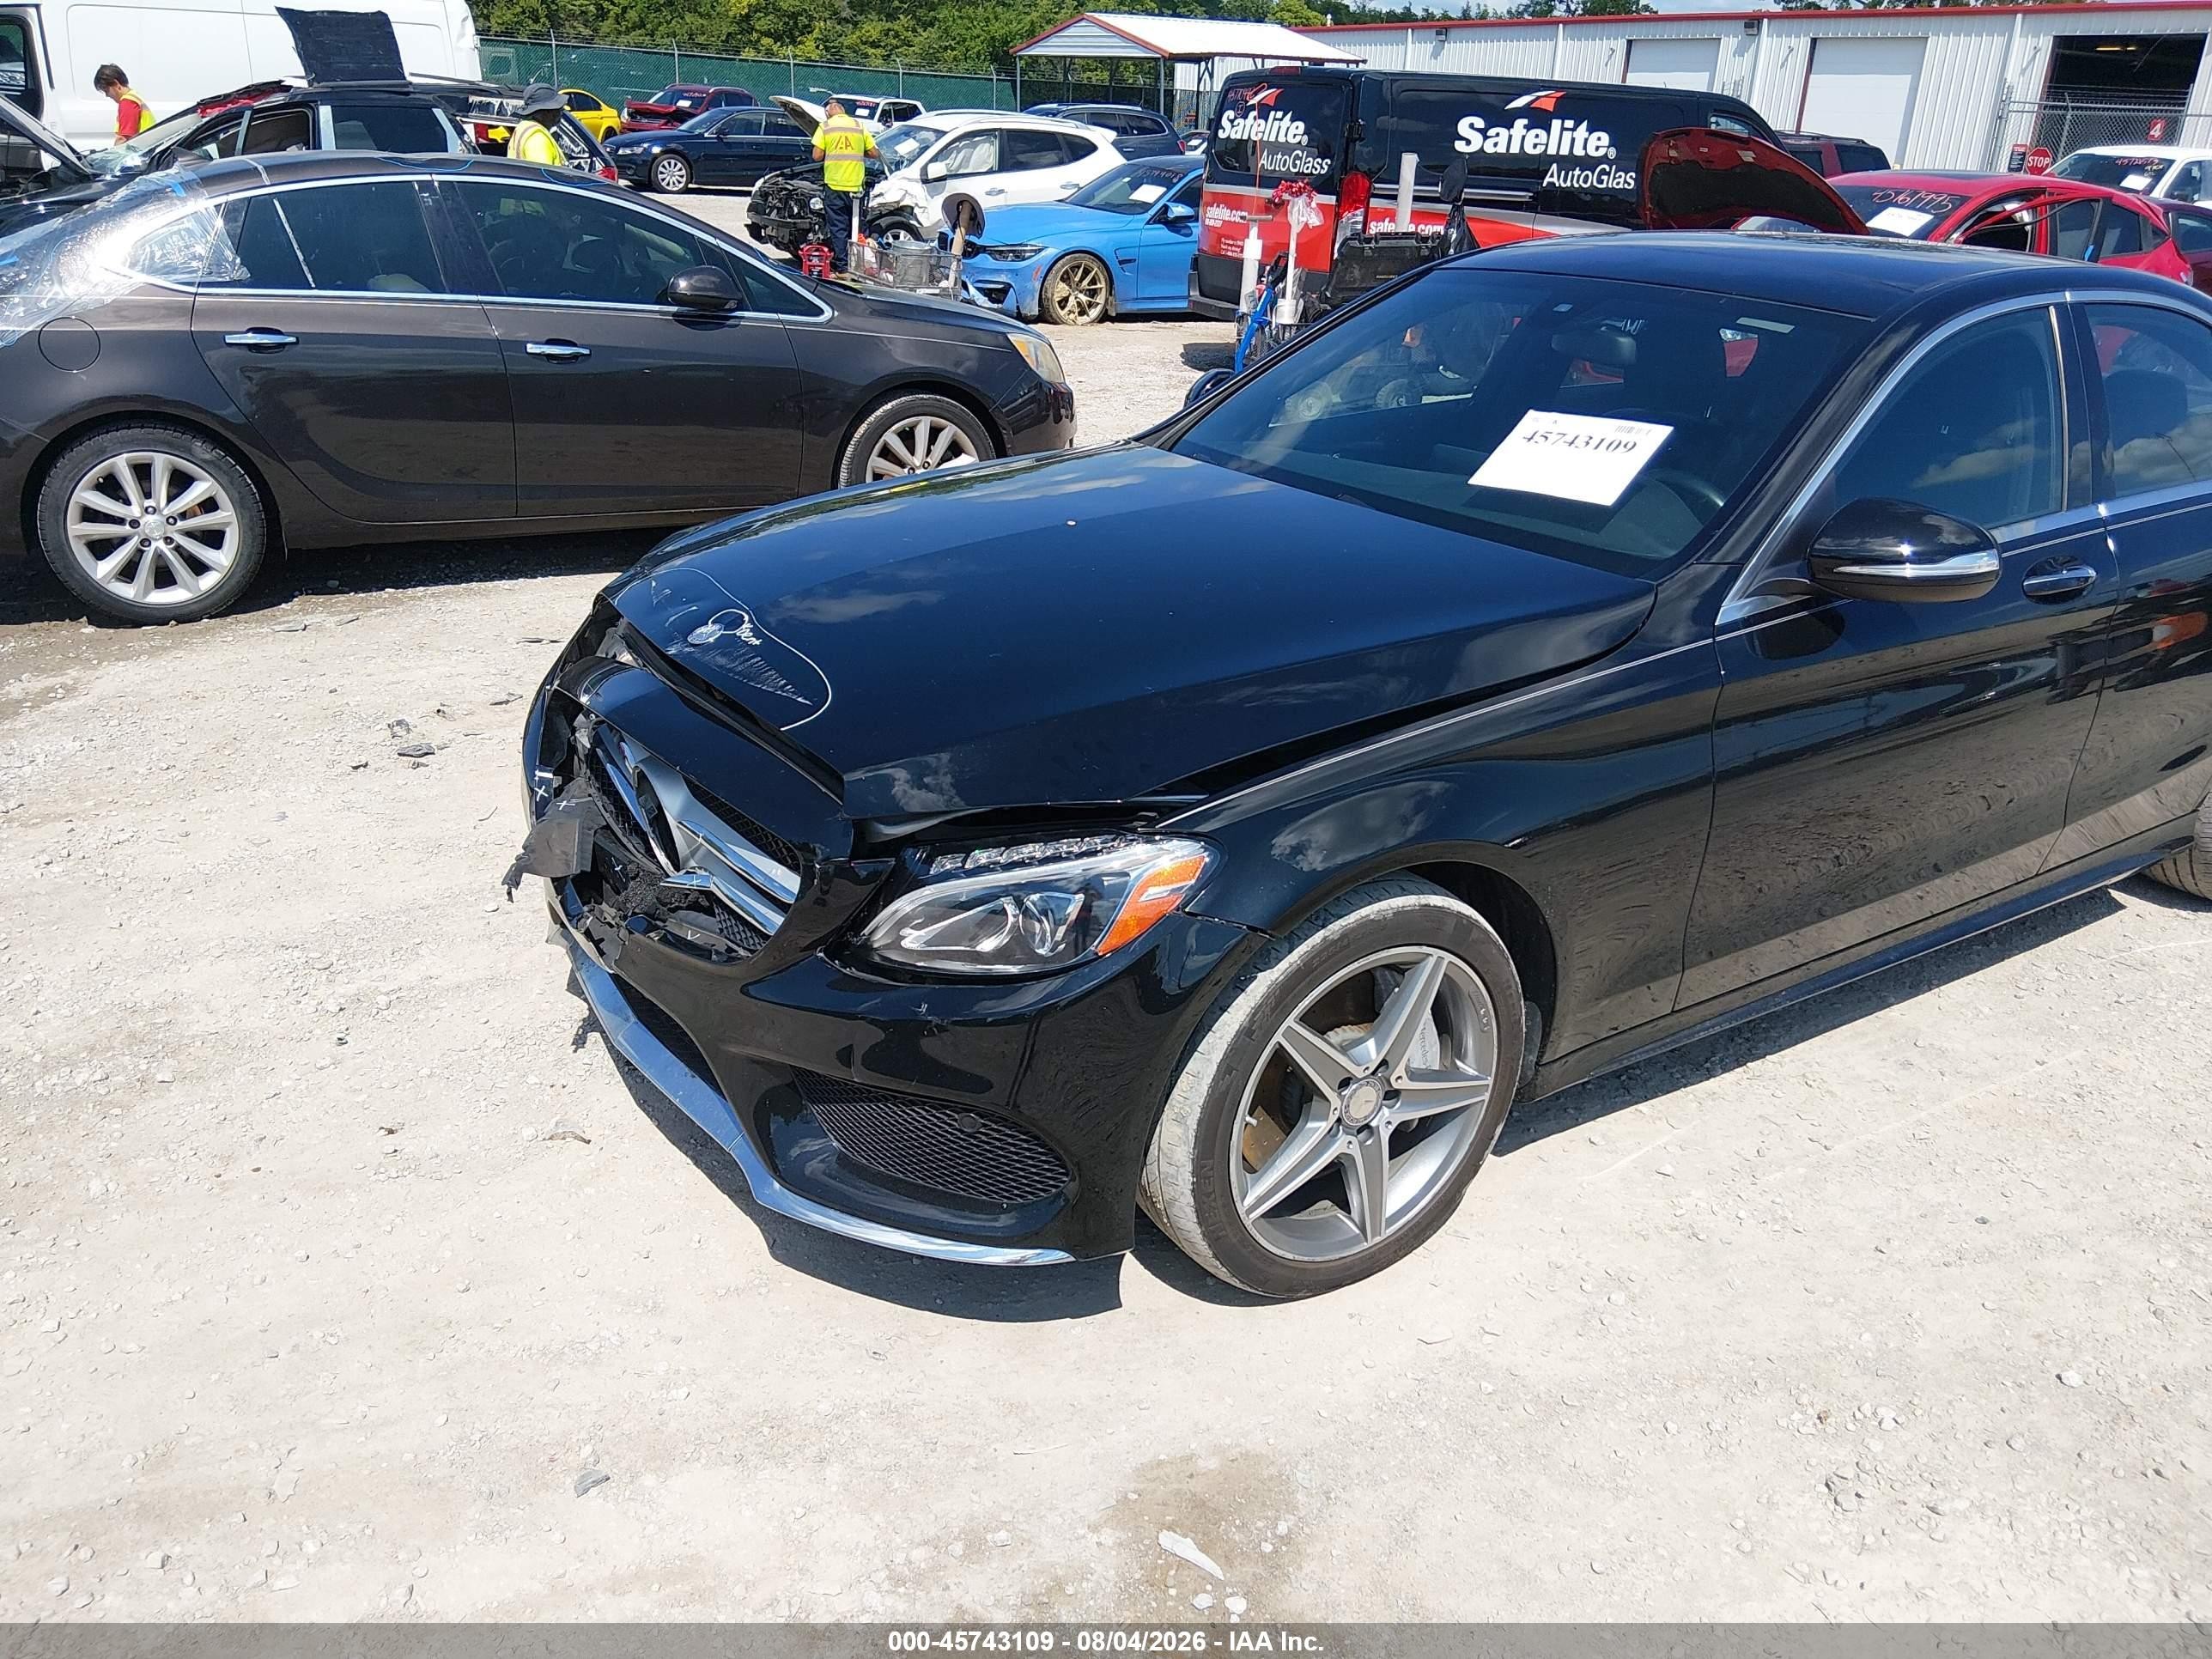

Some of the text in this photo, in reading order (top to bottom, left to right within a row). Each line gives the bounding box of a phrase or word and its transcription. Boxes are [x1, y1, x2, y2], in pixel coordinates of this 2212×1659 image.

[2149, 123, 2161, 138] 4
[1259, 149, 1331, 174] AutoGlass
[2027, 155, 2050, 168] STOP
[1542, 162, 1636, 190] AutoGlas
[1522, 429, 1638, 453] 45743109
